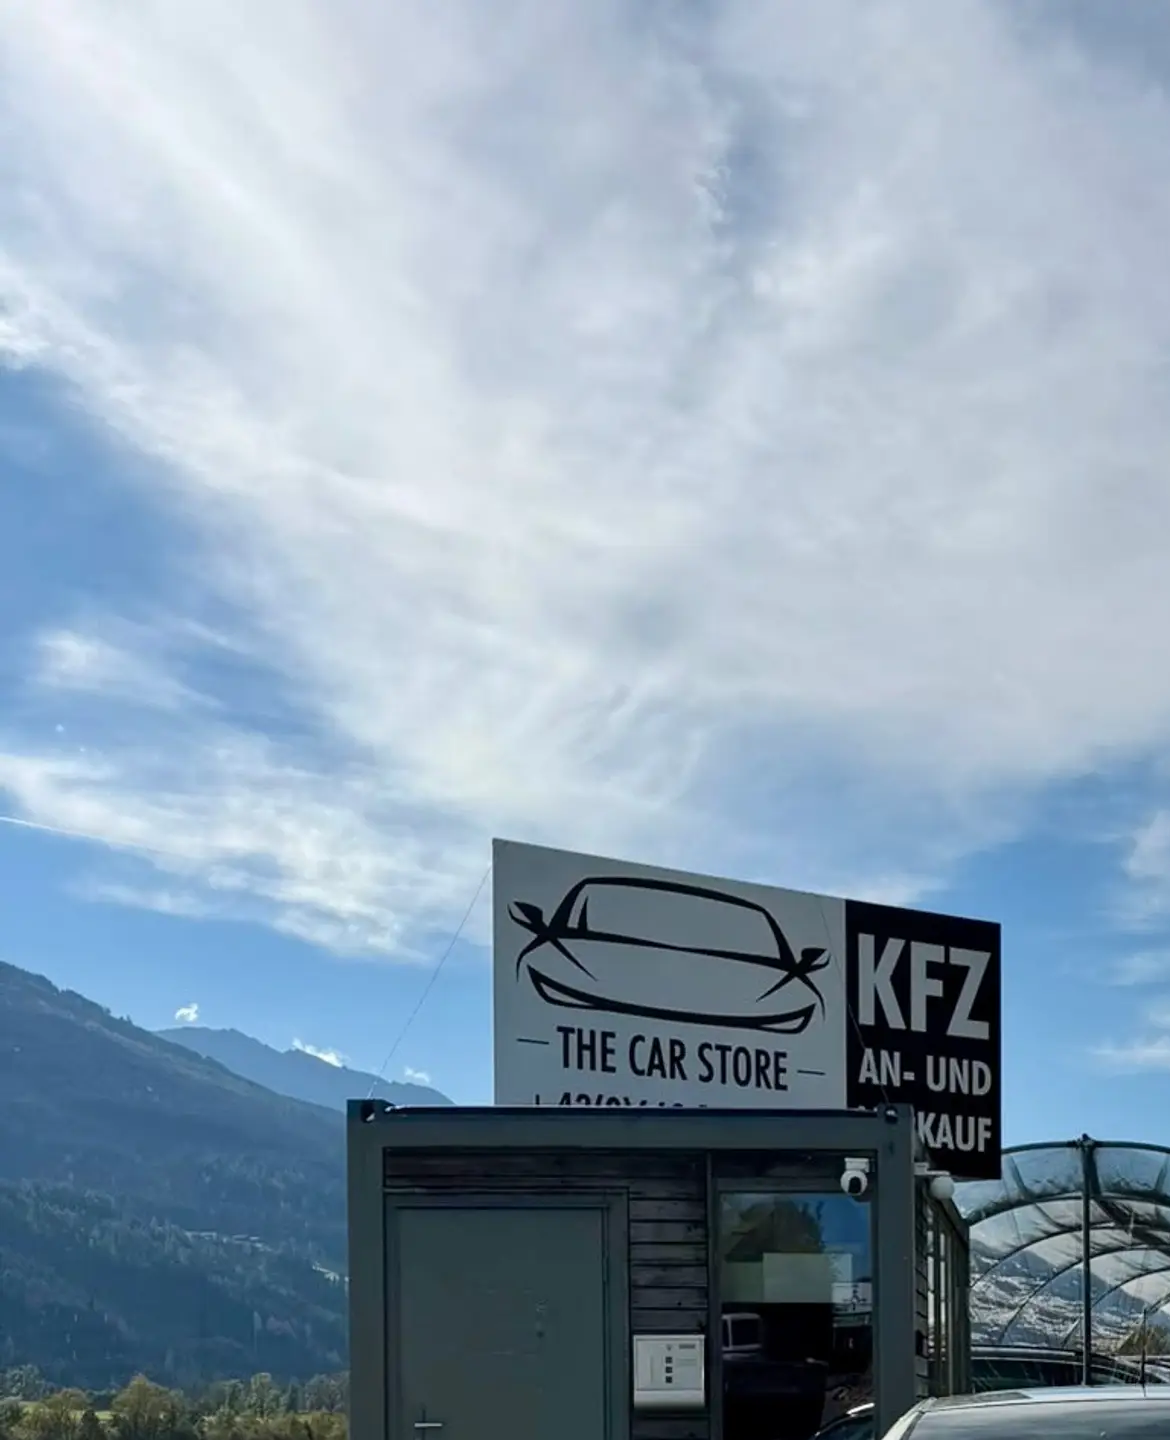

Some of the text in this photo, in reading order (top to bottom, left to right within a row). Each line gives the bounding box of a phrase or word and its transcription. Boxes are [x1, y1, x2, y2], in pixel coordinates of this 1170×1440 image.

[858, 932, 992, 1042] KFZ
[556, 1025, 789, 1092] THE CAR STORE
[858, 1047, 992, 1097] AN- UND
